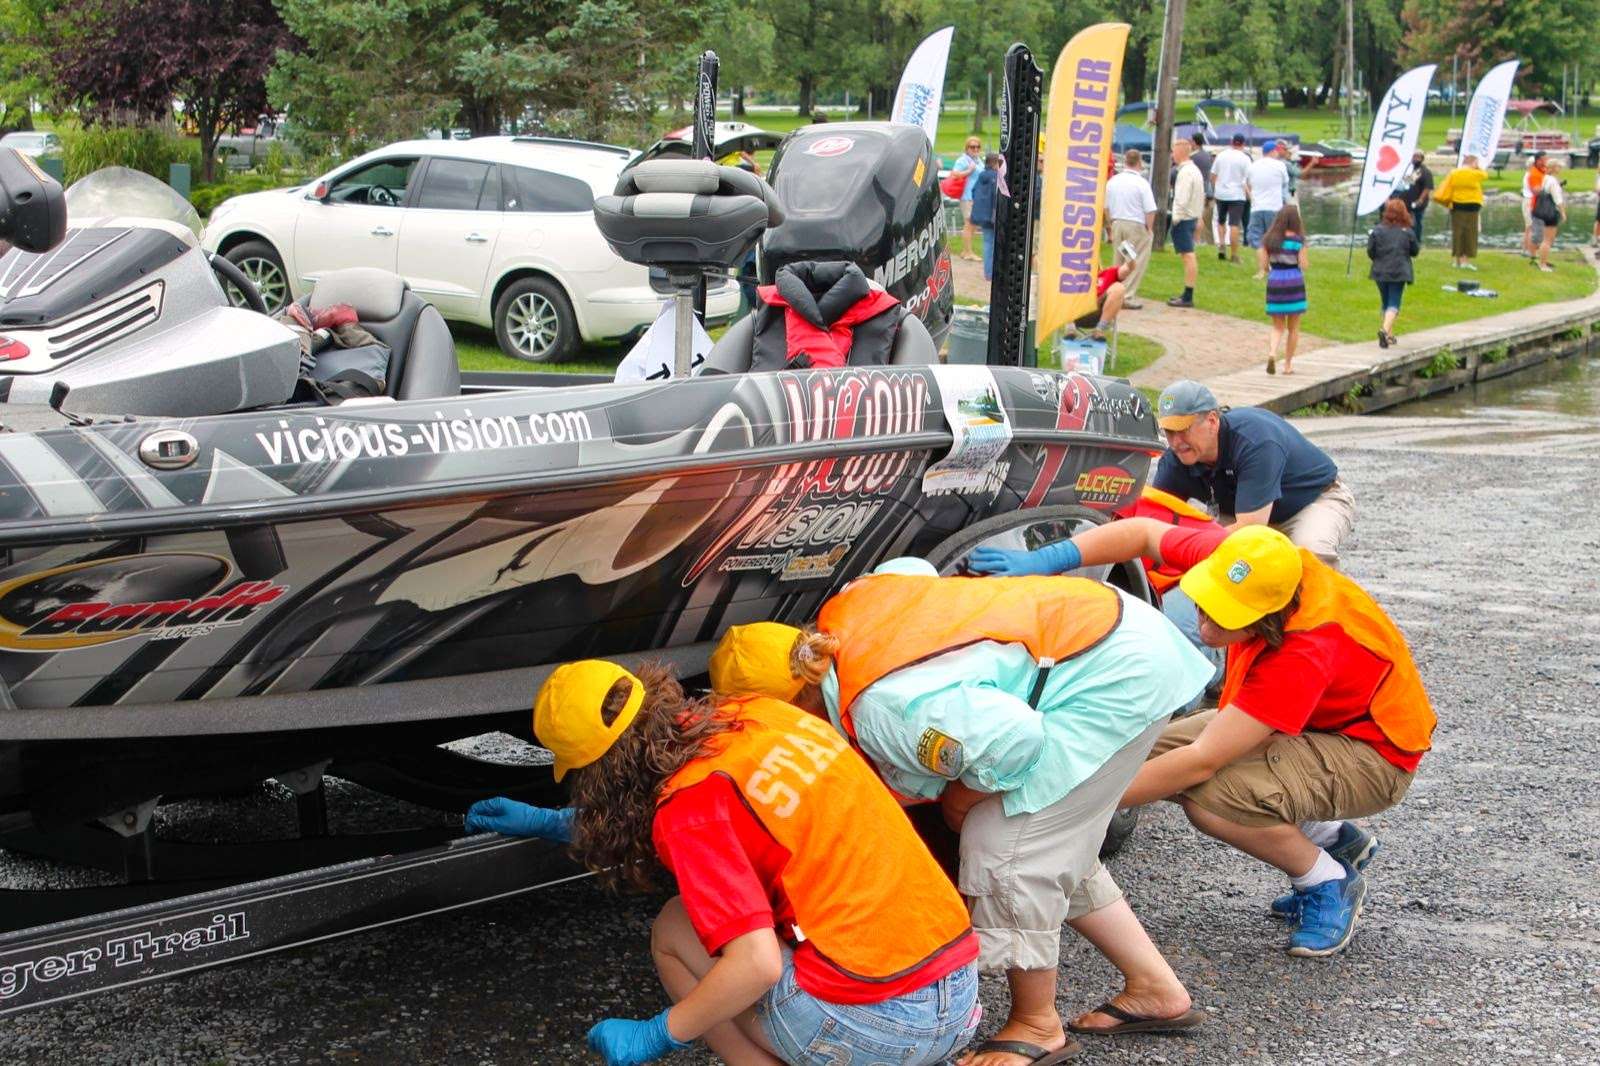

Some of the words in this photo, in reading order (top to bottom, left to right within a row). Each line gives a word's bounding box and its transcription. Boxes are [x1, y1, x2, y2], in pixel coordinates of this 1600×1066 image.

[1381, 89, 1413, 145] NY
[1059, 57, 1112, 295] BASSMASTER
[1372, 174, 1395, 188] I
[873, 207, 946, 290] MERCUR
[255, 407, 593, 466] vicious-vision.com
[1074, 472, 1137, 496] DUCKETT
[1080, 492, 1121, 503] FISHING
[20, 579, 289, 638] Bandit
[152, 622, 217, 641] LURES
[107, 911, 250, 968] Trail
